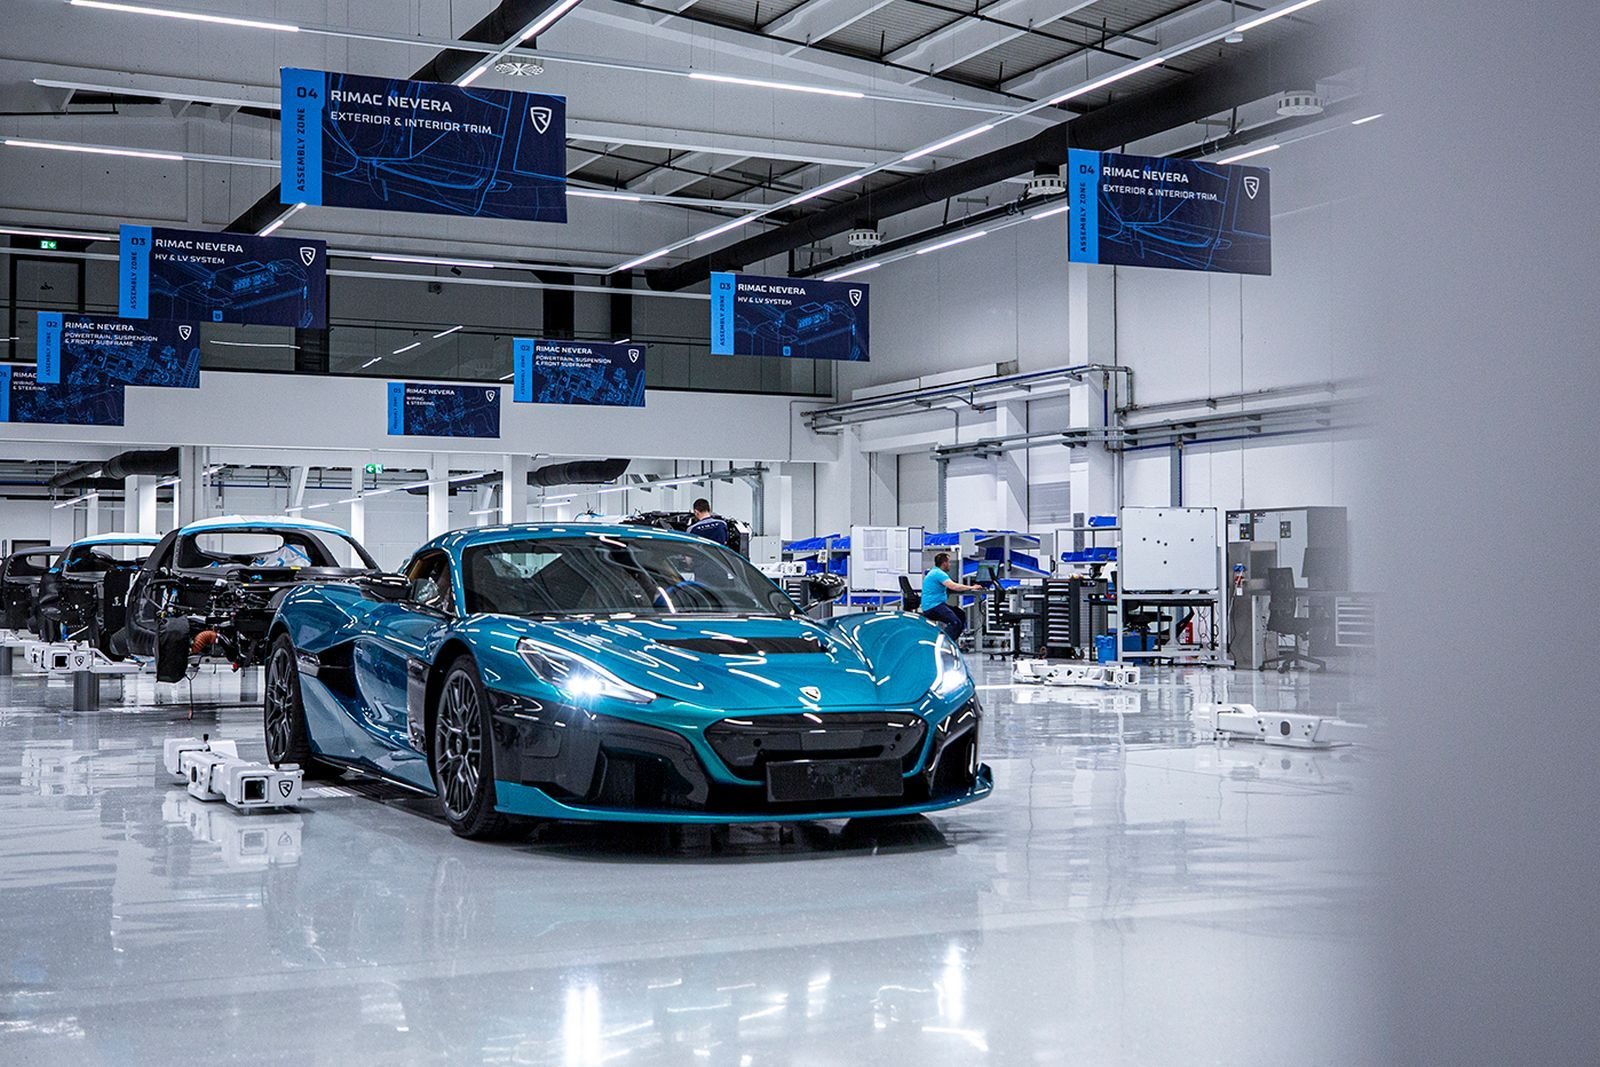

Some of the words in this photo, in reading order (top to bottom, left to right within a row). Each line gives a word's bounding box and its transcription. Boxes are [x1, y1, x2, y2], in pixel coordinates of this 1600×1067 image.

[296, 85, 319, 100] 04
[330, 89, 383, 107] RIMAC
[387, 95, 453, 113] NEVERA
[296, 107, 306, 135] ZONE
[330, 110, 391, 126] EXTERIOR
[393, 116, 403, 127] &
[404, 118, 460, 132] INTERIOR
[462, 123, 493, 135] TRIM
[296, 136, 306, 193] ASSEMBLY
[1079, 164, 1095, 175] 04
[1103, 166, 1140, 179] RIMAC
[1142, 170, 1189, 183] NEVERA
[1079, 182, 1087, 206] ZONE
[1103, 184, 1146, 196] EXTERIOR
[1147, 188, 1154, 196] &
[1155, 188, 1195, 200] INTERIOR
[1196, 191, 1218, 201] TRIM
[1079, 207, 1087, 253] ASSEMBLY
[130, 236, 146, 246] 03
[155, 238, 193, 250] RIMAC
[196, 241, 244, 253] NEVERA
[154, 253, 168, 261] HV
[169, 254, 176, 262] &
[177, 254, 189, 263] LV
[189, 255, 225, 265] SYSTEM
[738, 283, 767, 293] RIMAC
[769, 285, 806, 295] NEVERA
[764, 298, 792, 306] SYSTEM
[46, 320, 58, 328] 02
[64, 321, 95, 330] RIMAC
[96, 323, 135, 332] NEVERA
[113, 334, 158, 342] SUSPENSION
[535, 345, 560, 353] RIMAC
[561, 346, 593, 355] NEVERA
[13, 371, 37, 379] RIMAC
